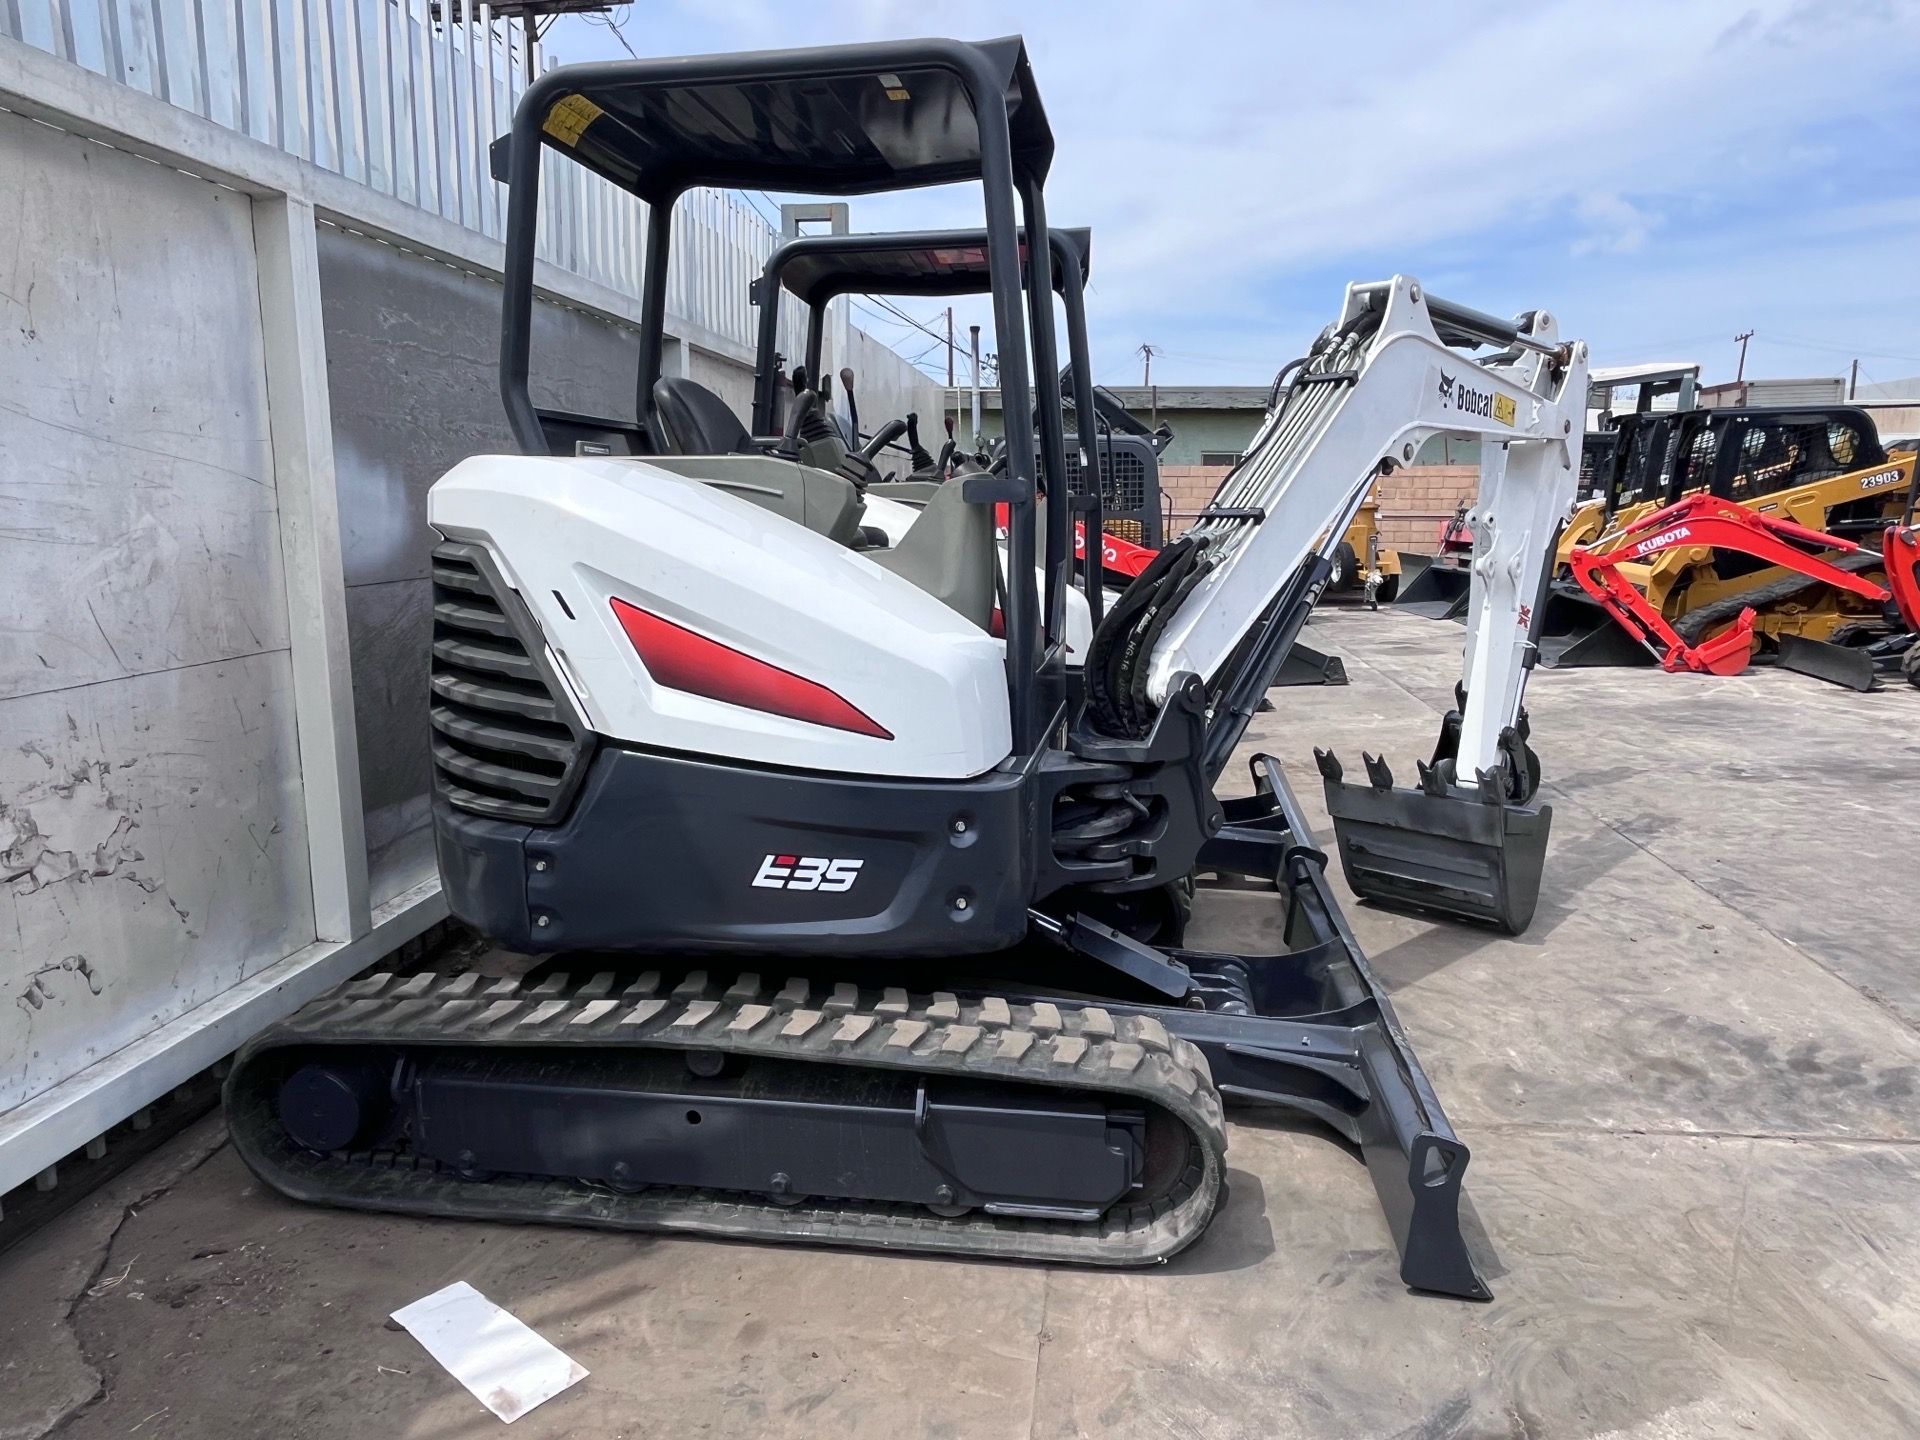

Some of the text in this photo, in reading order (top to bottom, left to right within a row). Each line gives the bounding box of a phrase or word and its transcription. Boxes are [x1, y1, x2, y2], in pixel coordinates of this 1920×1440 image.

[1457, 384, 1494, 419] Bobcat
[1860, 470, 1900, 489] 239D3
[1636, 527, 1692, 554] KUBOTA
[751, 854, 864, 892] E35
